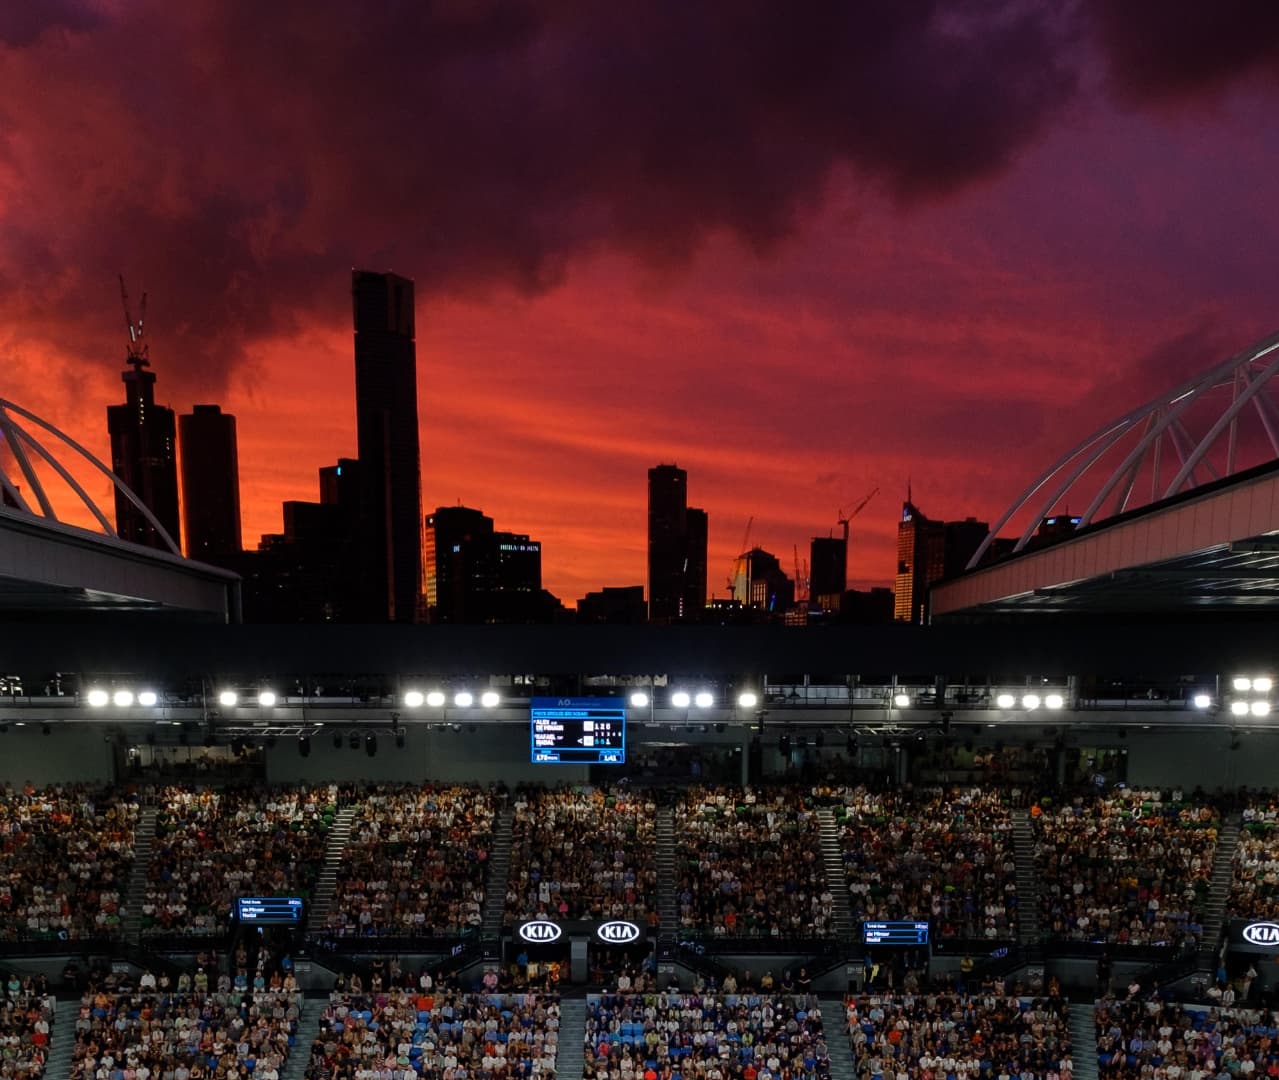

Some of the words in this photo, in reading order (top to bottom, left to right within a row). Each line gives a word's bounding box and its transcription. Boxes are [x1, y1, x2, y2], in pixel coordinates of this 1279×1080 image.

[528, 926, 554, 937] KIA
[606, 926, 632, 937] KIA
[1252, 928, 1279, 940] KIA
